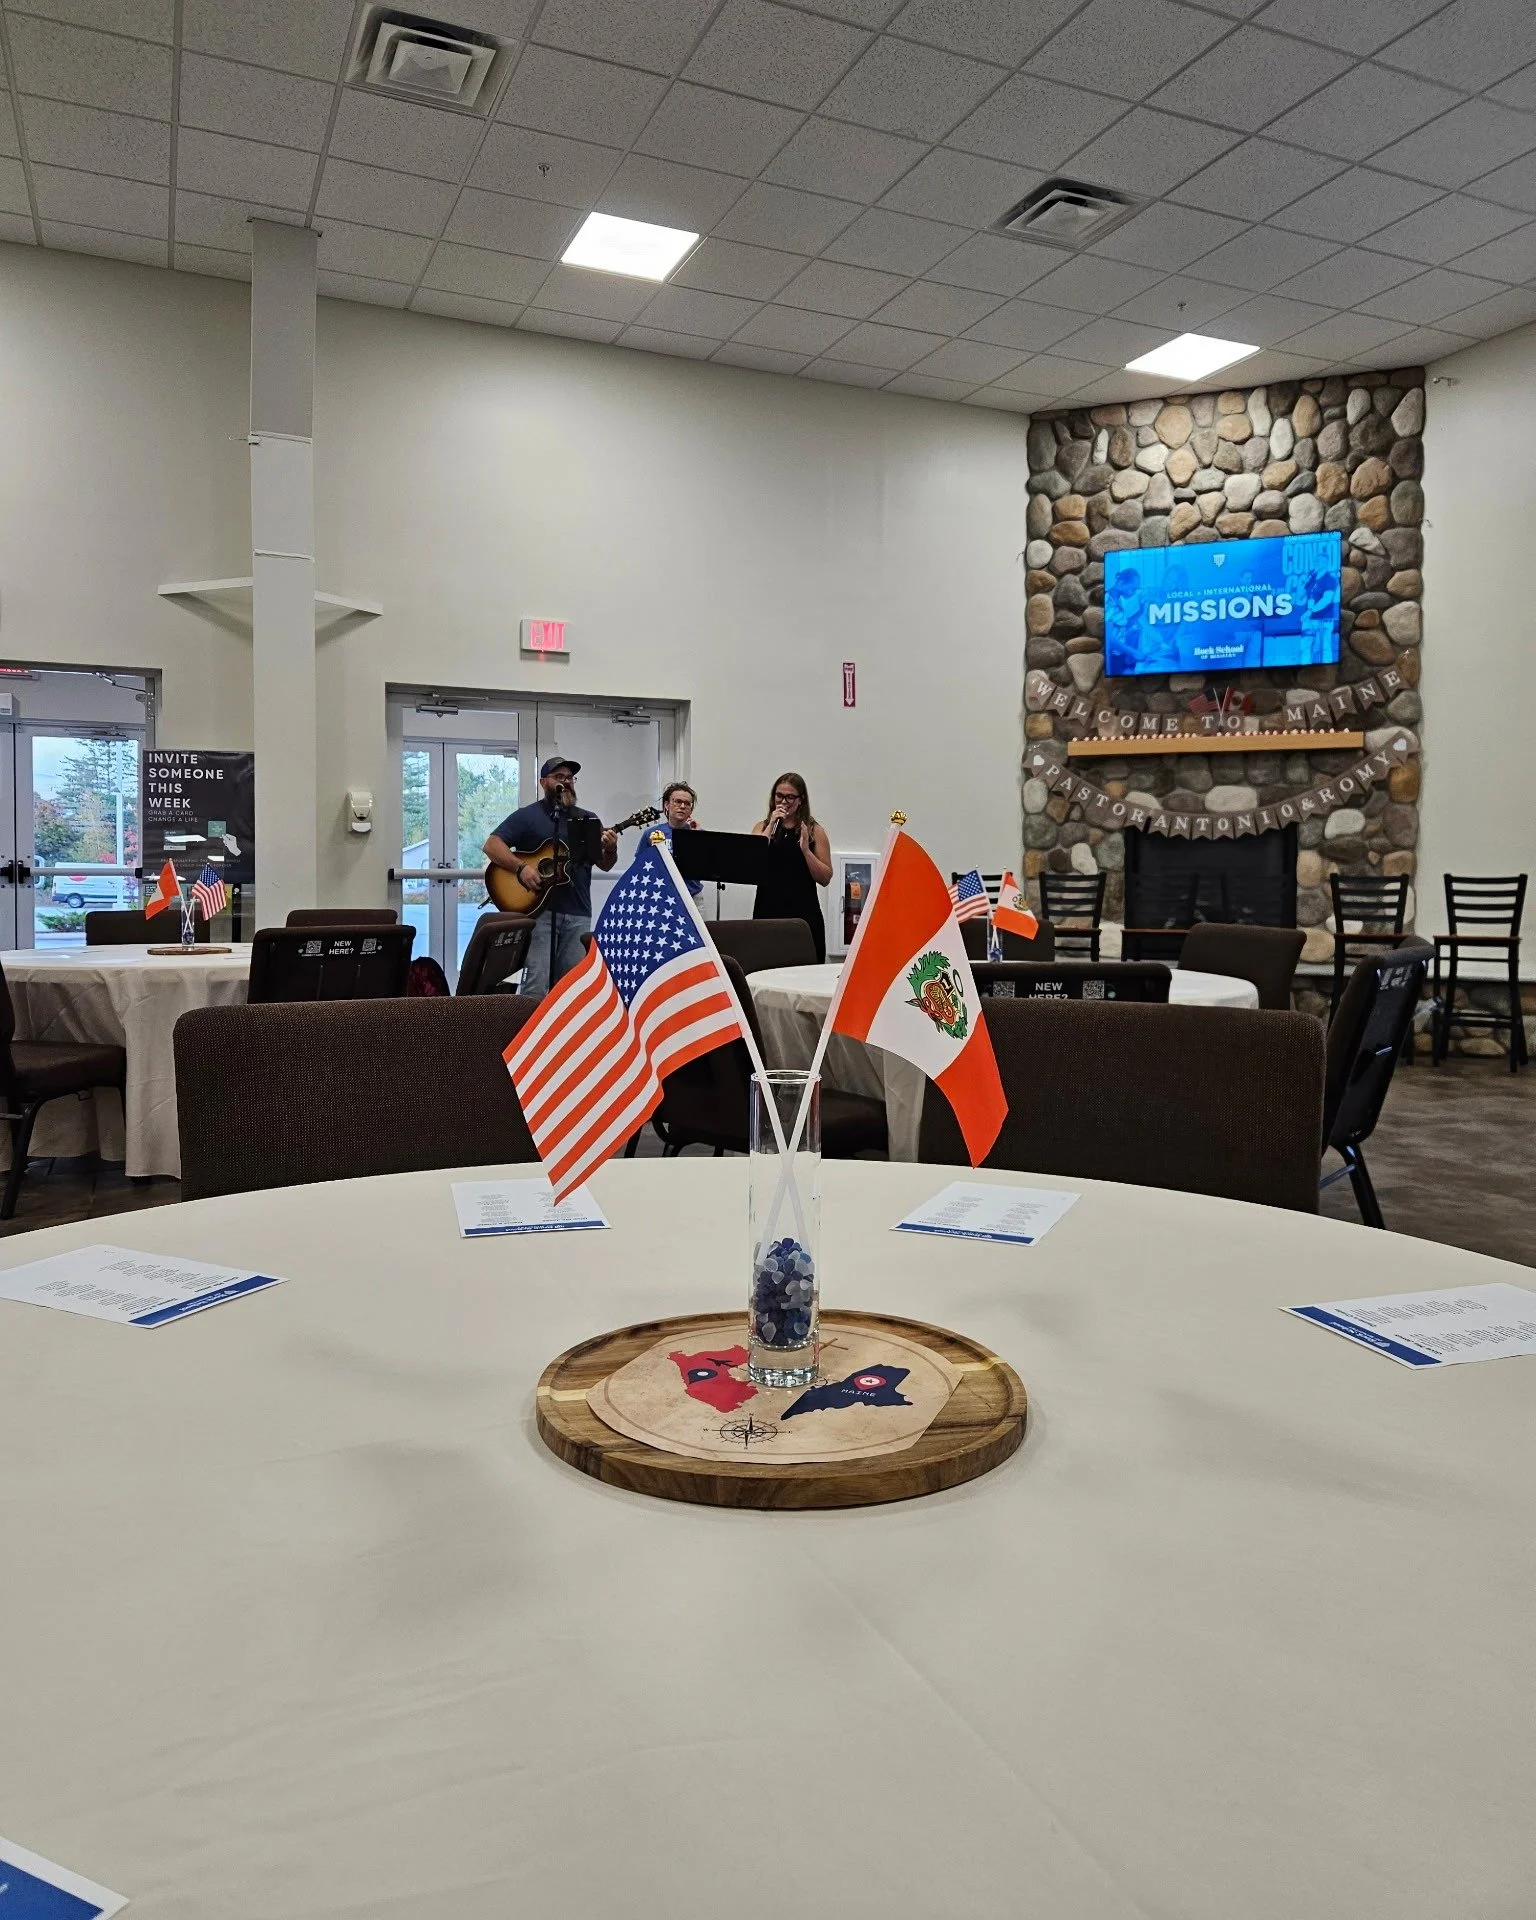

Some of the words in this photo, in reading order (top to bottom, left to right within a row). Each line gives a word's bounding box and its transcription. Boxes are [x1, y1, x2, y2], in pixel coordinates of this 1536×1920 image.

[1166, 591, 1194, 599] LOCAL
[1203, 583, 1273, 596] INTERNATIONAL
[1149, 593, 1293, 625] MISSIONS
[530, 620, 565, 650] EXIT
[1036, 681, 1180, 732] WELCOME
[1202, 715, 1242, 730] TO
[1286, 670, 1401, 723] MAINE
[148, 753, 198, 764] INVITE
[148, 768, 224, 780] SOMEONE
[148, 782, 183, 794] THIS
[1044, 763, 1144, 823] PASTOR
[1153, 803, 1294, 832] ANTONIO
[1317, 750, 1391, 804] ROMY
[148, 797, 191, 808] WEEK
[1035, 982, 1063, 991] NEW
[841, 1388, 878, 1398] MAINE
